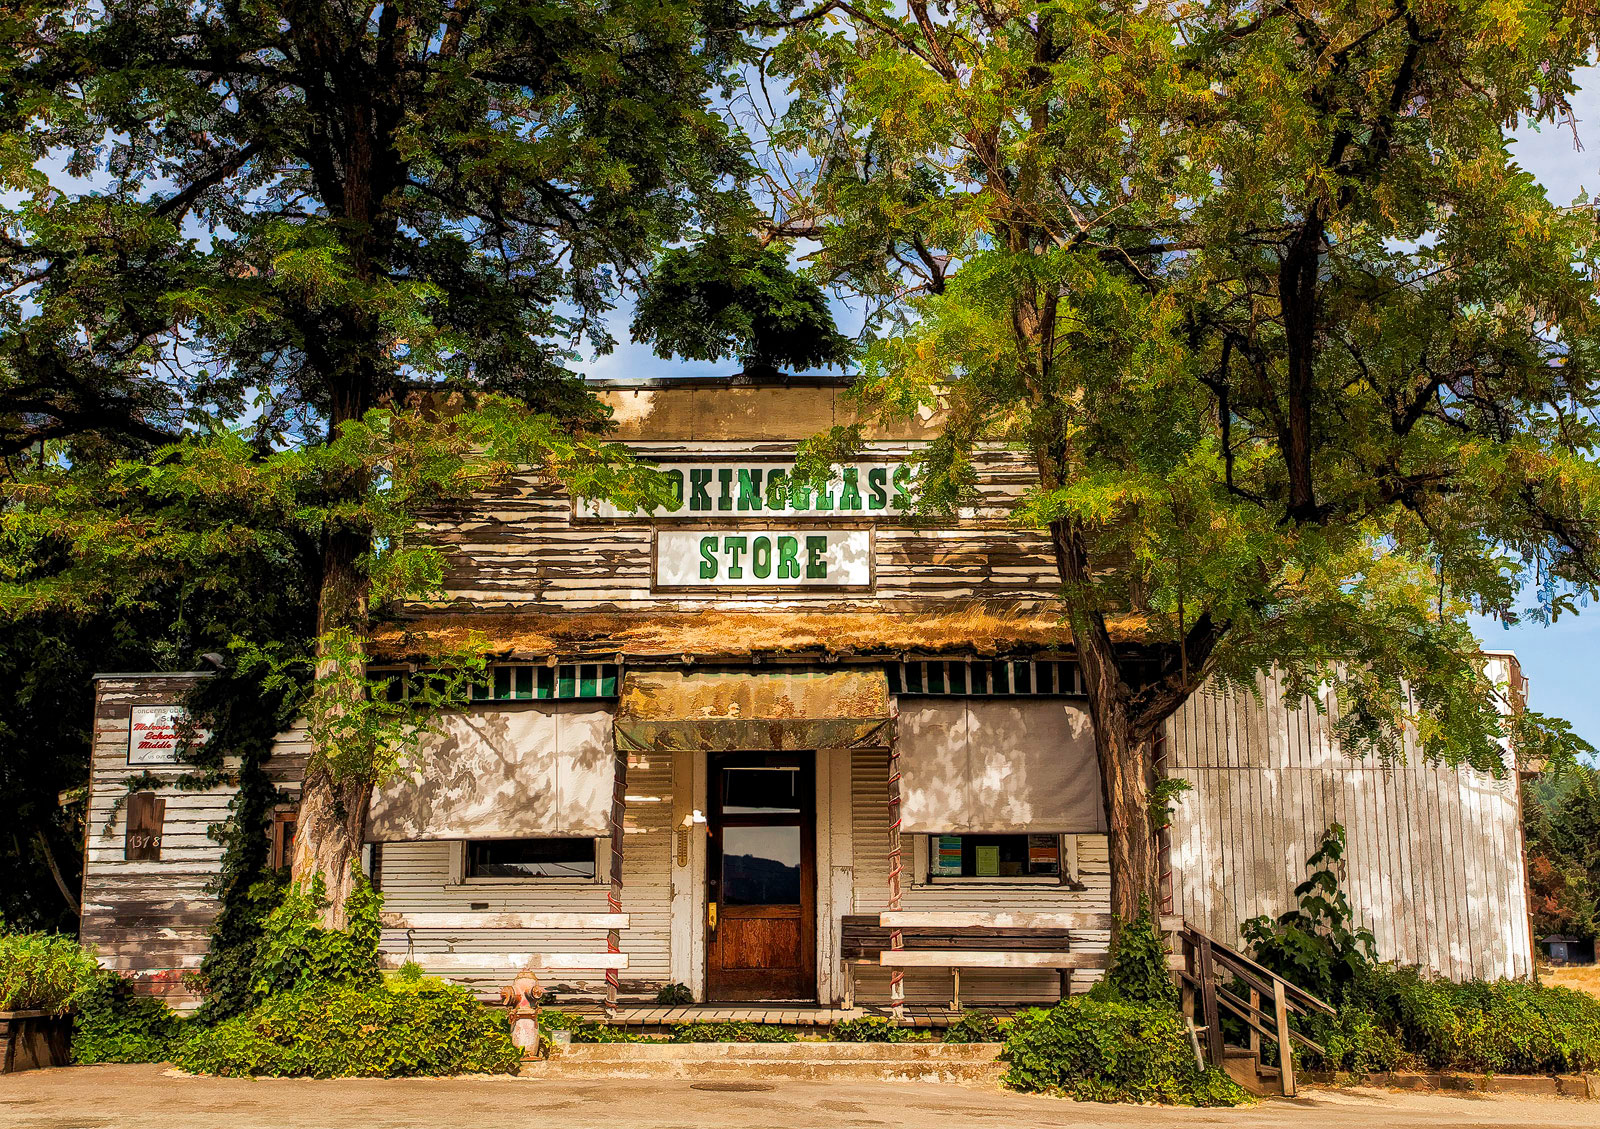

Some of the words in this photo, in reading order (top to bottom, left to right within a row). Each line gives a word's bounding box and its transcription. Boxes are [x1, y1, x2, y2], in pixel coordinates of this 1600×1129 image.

[699, 536, 827, 579] STORE
[133, 722, 171, 731] Melrose
[138, 741, 172, 749] Middle
